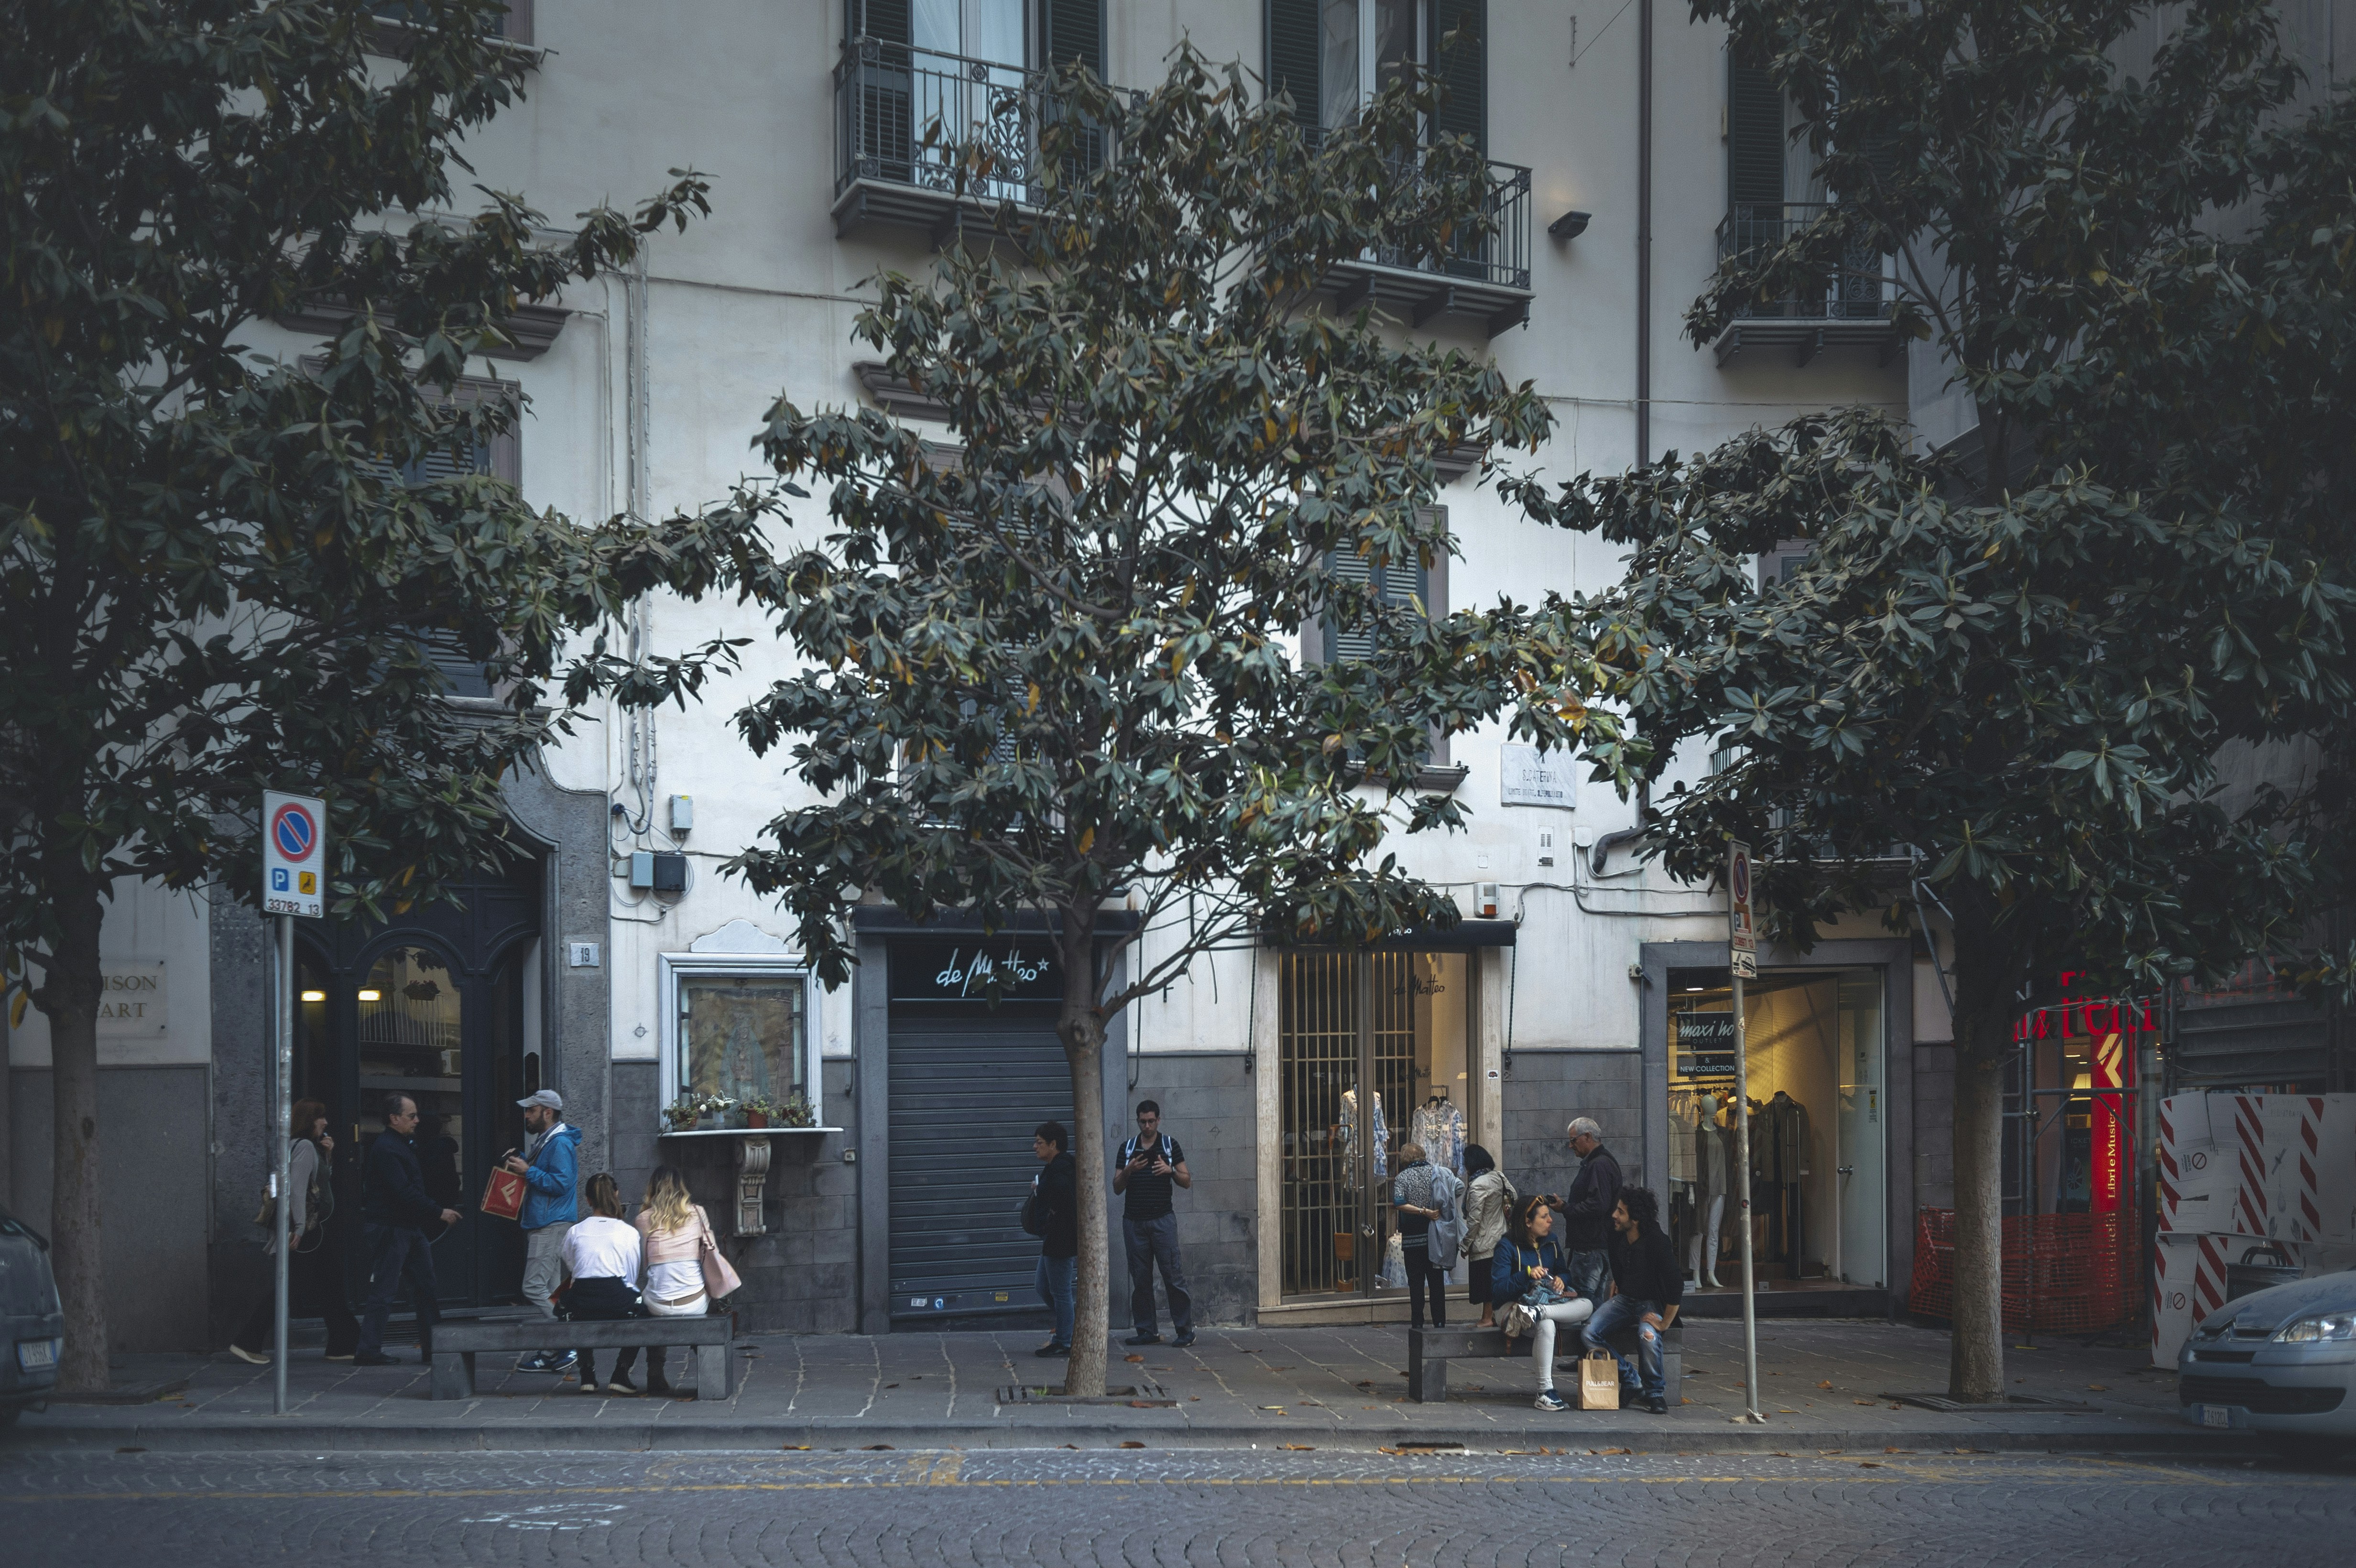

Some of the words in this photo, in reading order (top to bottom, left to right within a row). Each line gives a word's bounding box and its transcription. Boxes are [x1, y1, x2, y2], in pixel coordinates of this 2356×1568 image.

[275, 871, 286, 888] P
[268, 898, 300, 913] 33782
[308, 904, 320, 915] 13
[581, 947, 590, 962] 19
[936, 947, 963, 987] de
[961, 948, 1037, 998] Mtteo
[103, 975, 158, 991] ISON
[99, 1002, 147, 1018] ART
[1679, 1020, 1716, 1037] maxi
[2110, 1158, 2116, 1167] e
